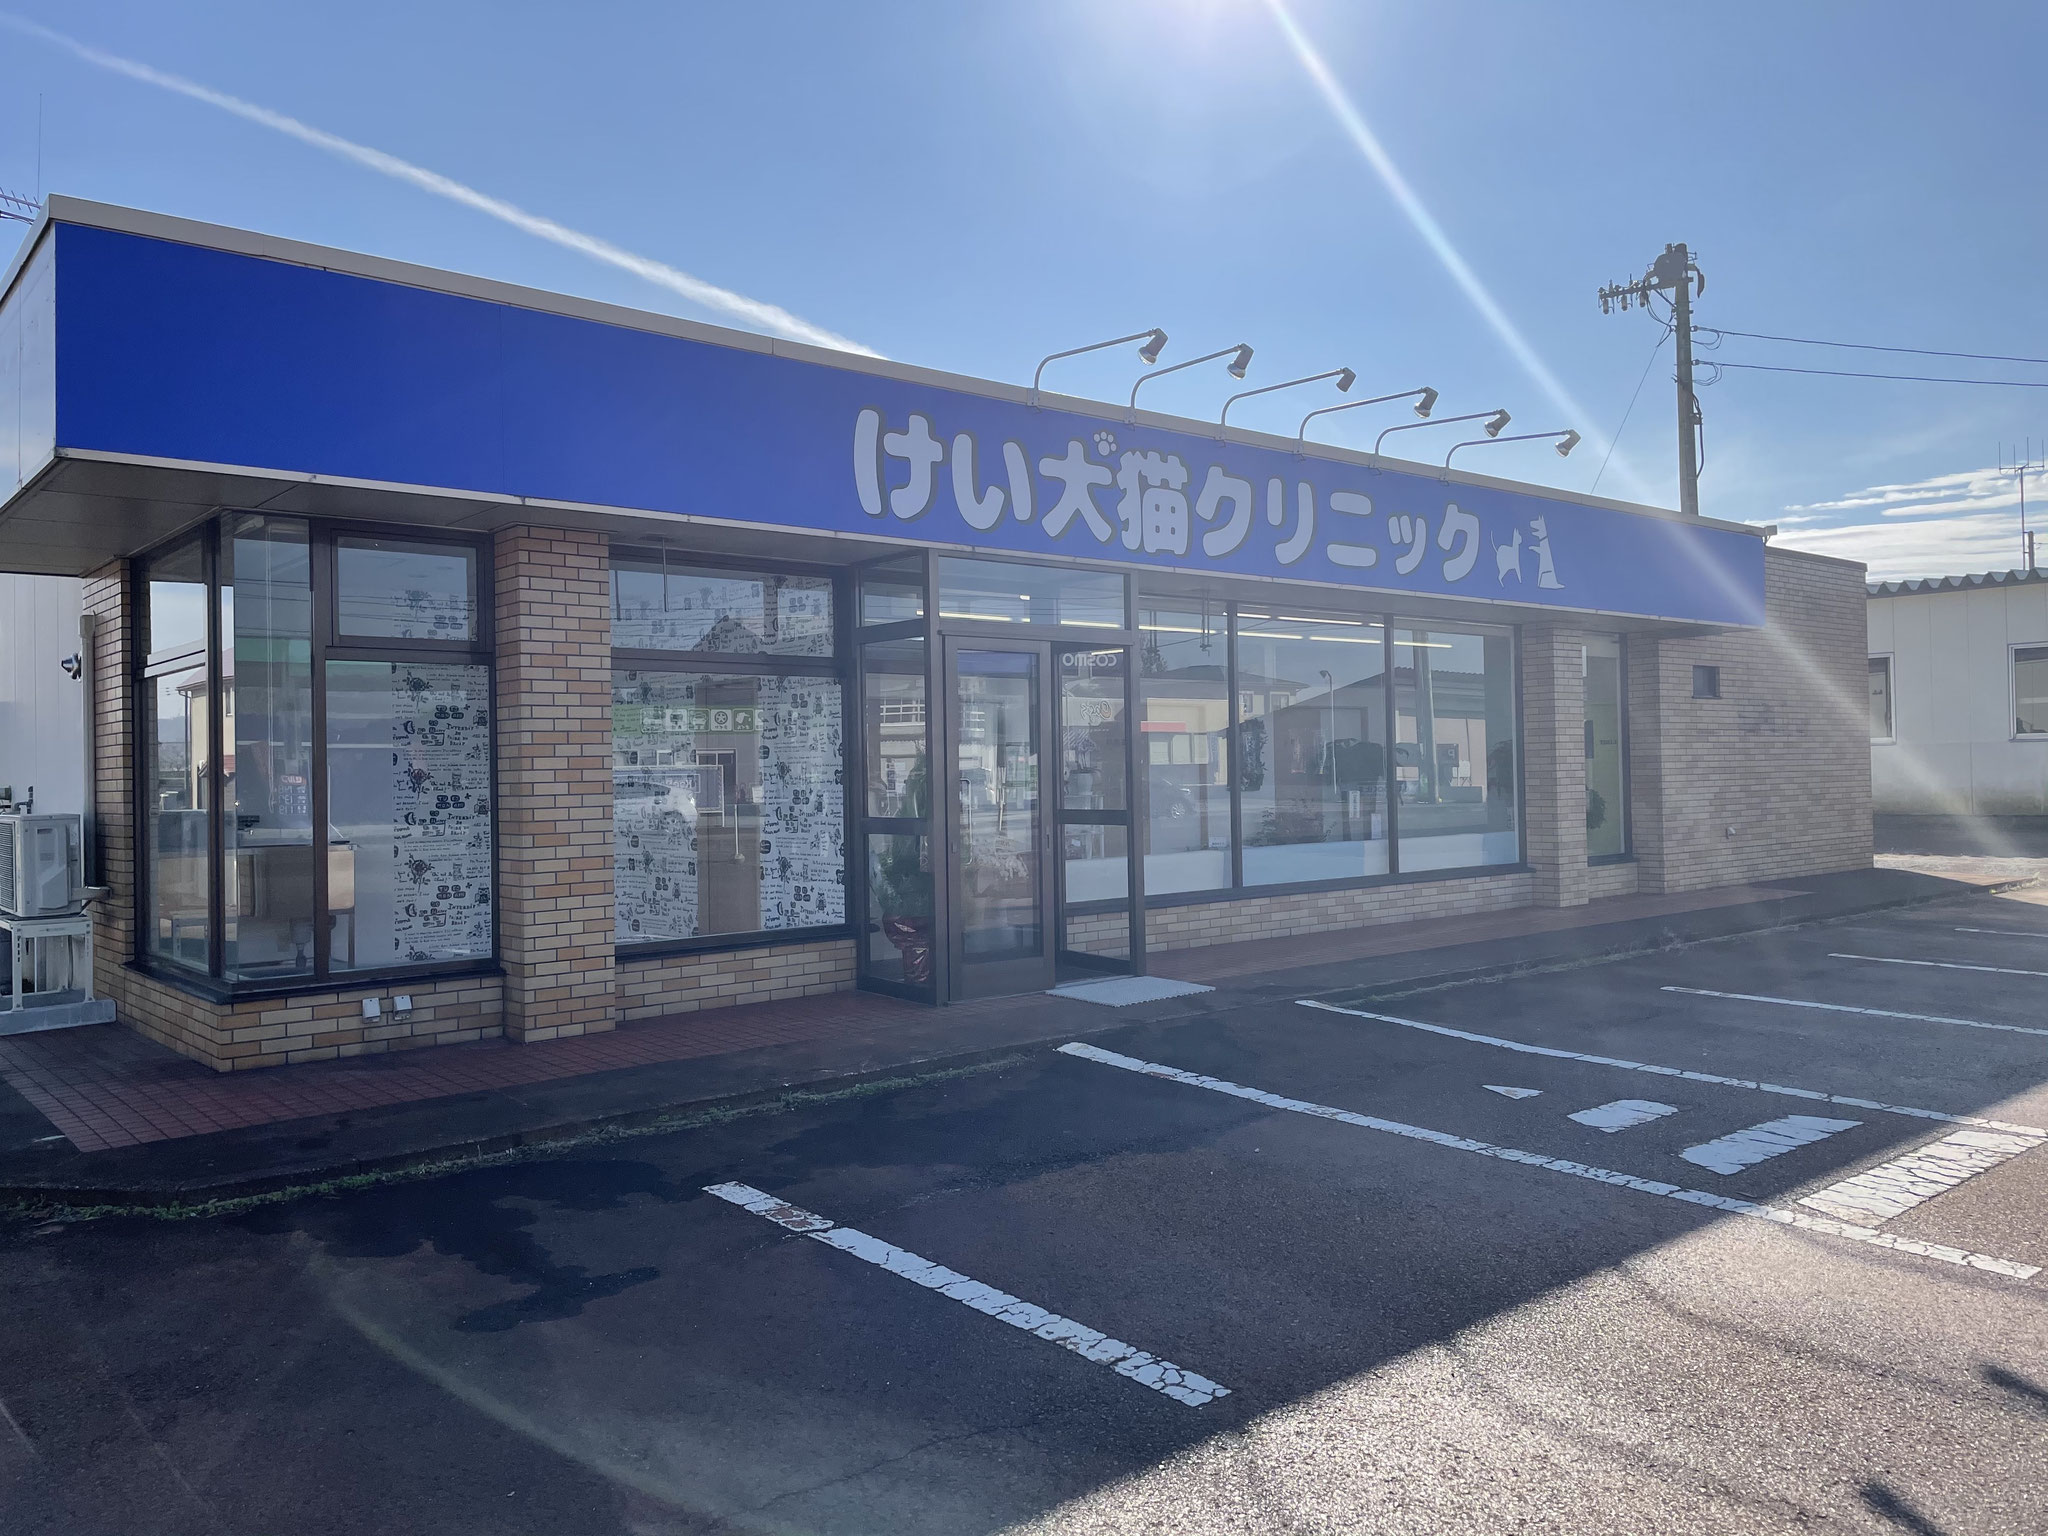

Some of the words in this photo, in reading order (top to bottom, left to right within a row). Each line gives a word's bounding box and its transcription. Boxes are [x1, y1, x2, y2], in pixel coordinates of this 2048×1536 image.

[852, 404, 1482, 585] けい犬猫クリニック
